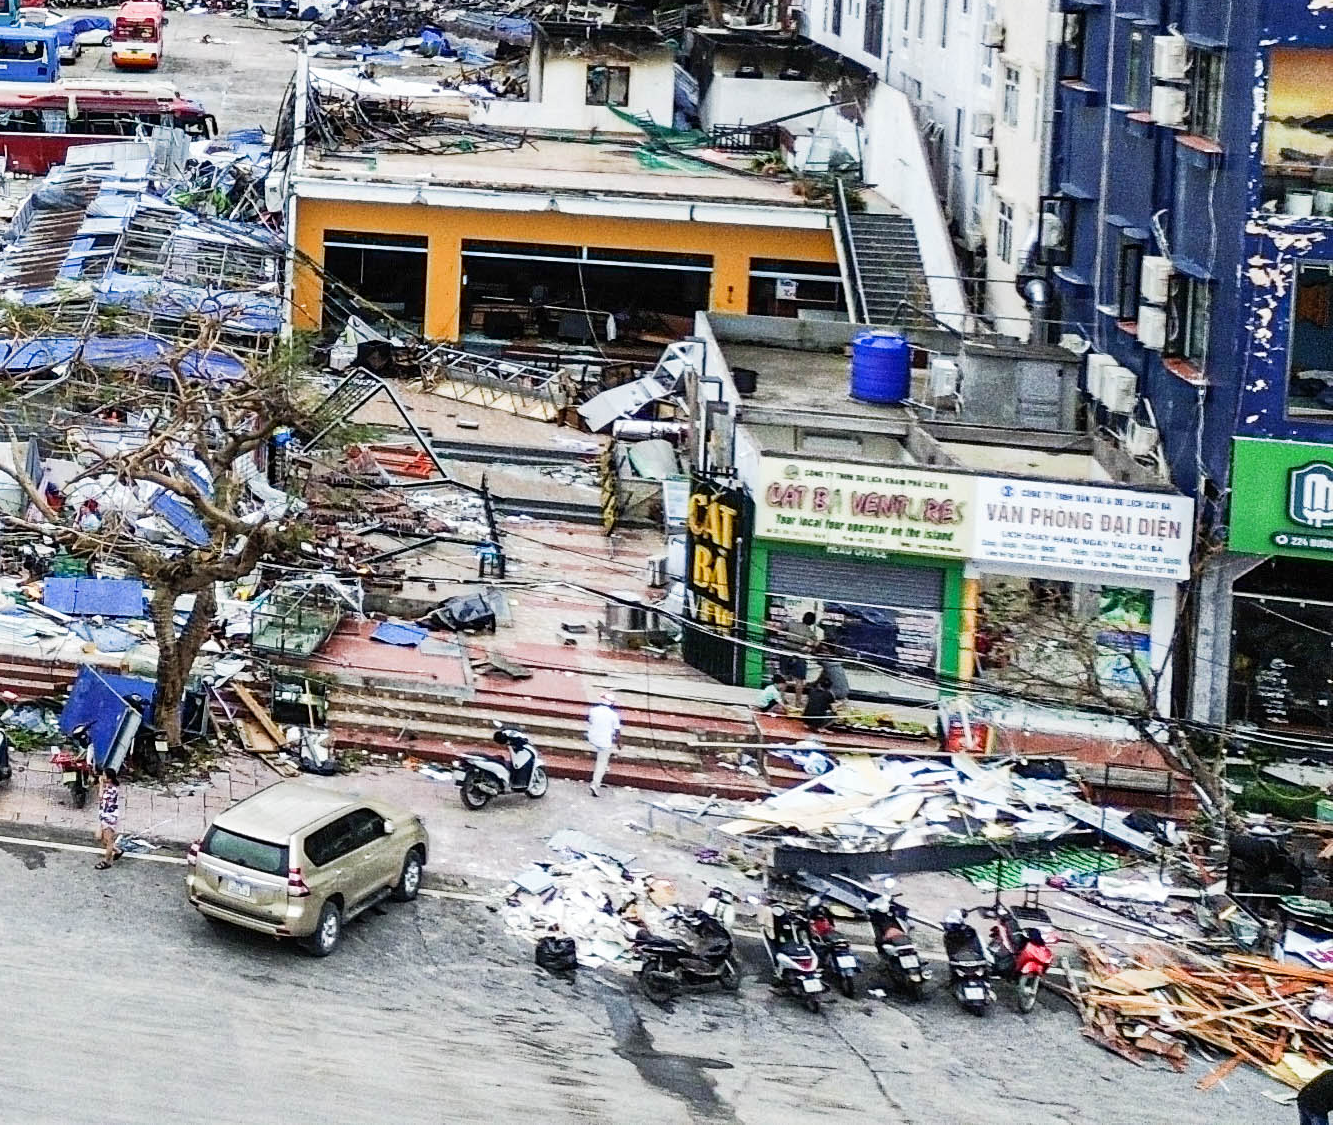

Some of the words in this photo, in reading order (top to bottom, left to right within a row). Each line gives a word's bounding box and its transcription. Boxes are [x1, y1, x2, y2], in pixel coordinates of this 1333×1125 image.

[986, 499, 1023, 524] VĂN
[1030, 505, 1094, 532] PHÒNG
[1100, 514, 1133, 536] ĐẠI
[1138, 515, 1182, 542] DIỆN
